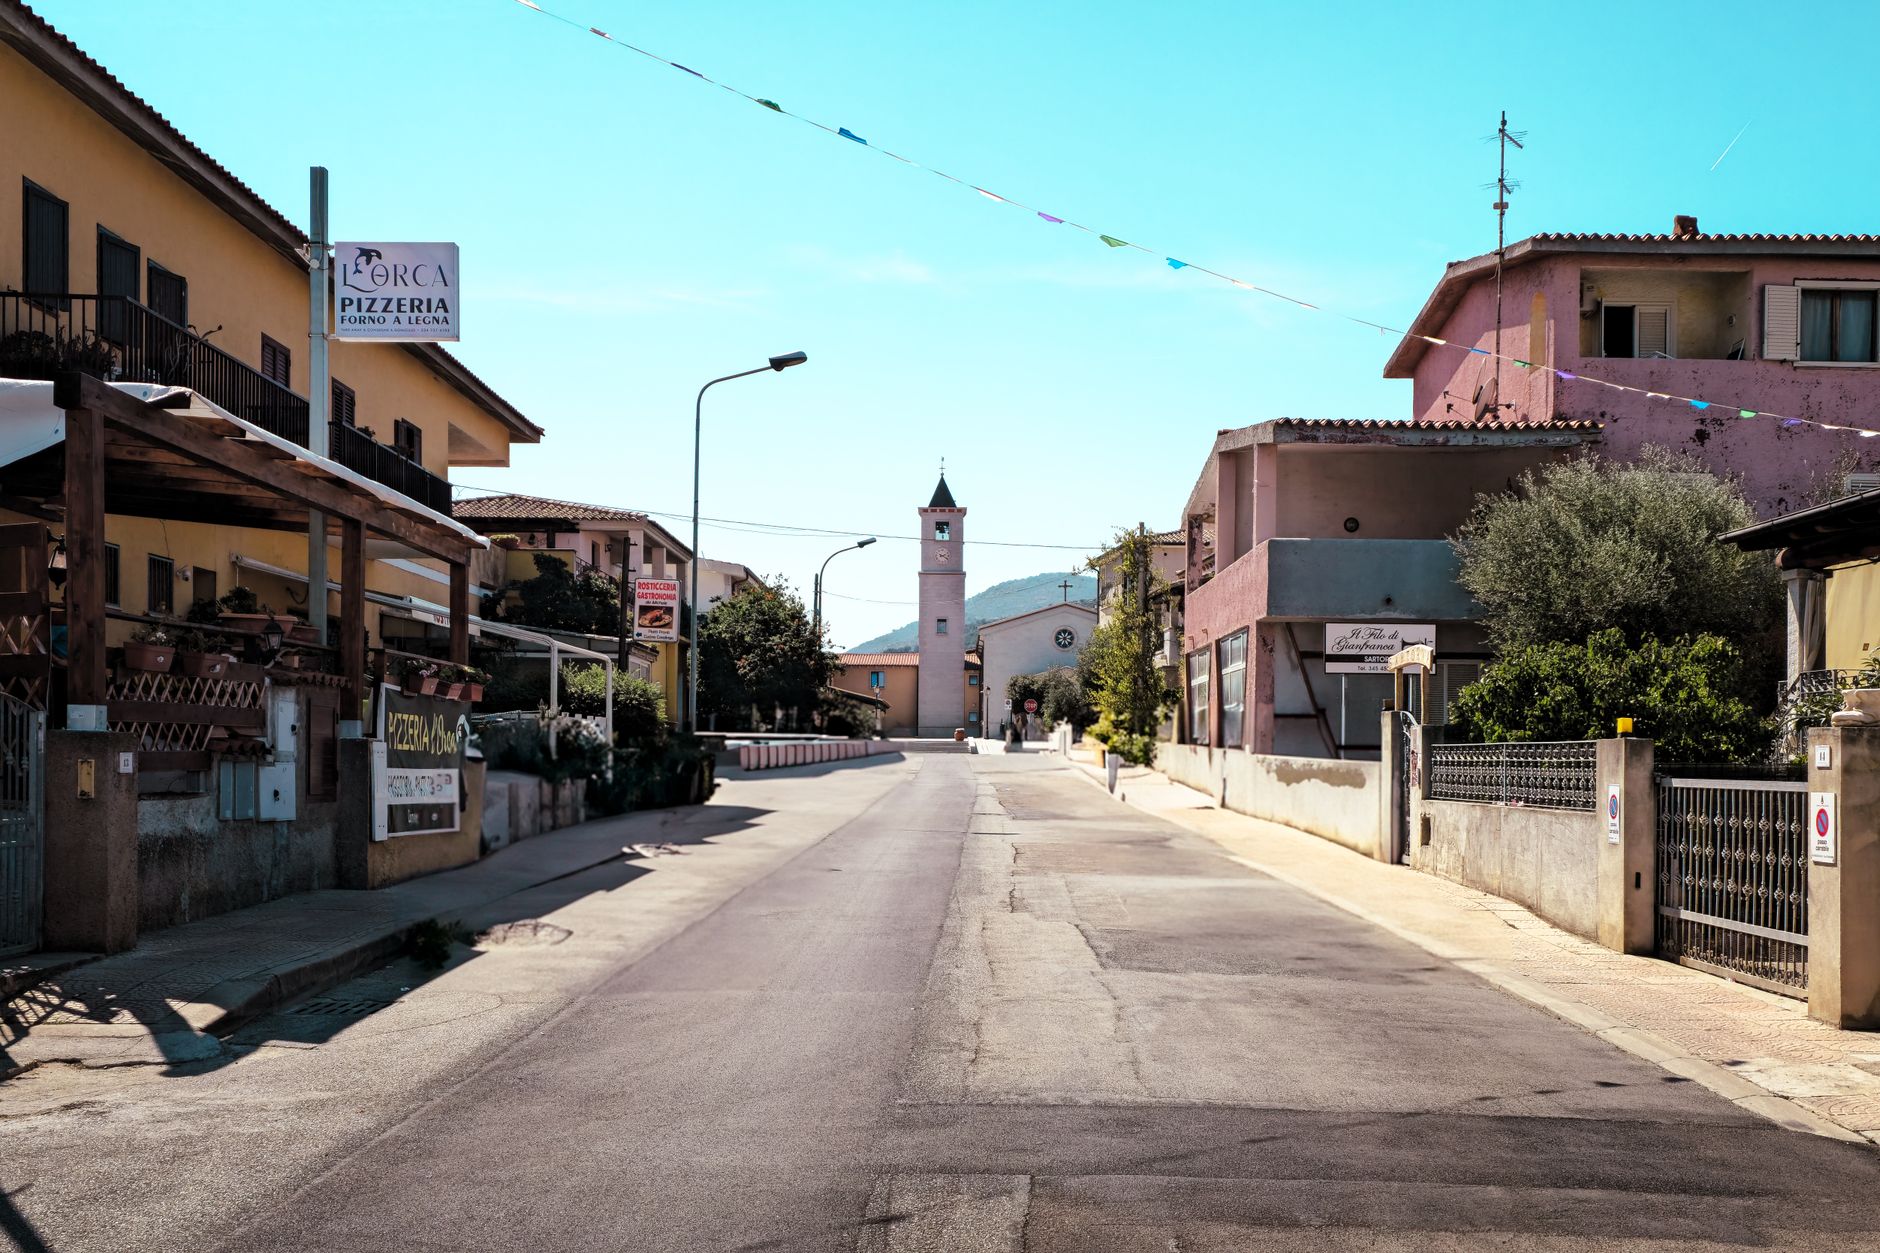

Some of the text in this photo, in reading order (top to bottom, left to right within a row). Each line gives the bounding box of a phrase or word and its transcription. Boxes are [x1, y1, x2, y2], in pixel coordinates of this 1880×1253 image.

[341, 297, 450, 313] PIZZERIA
[341, 315, 450, 325] FORNO A LEGNA
[638, 582, 677, 591] ROSTICCERIA
[637, 592, 677, 601] GASTRONOMIA
[1344, 627, 1400, 640] Il Filo di
[1331, 636, 1396, 654] Gianfranca
[388, 711, 429, 751] PIZZERIA
